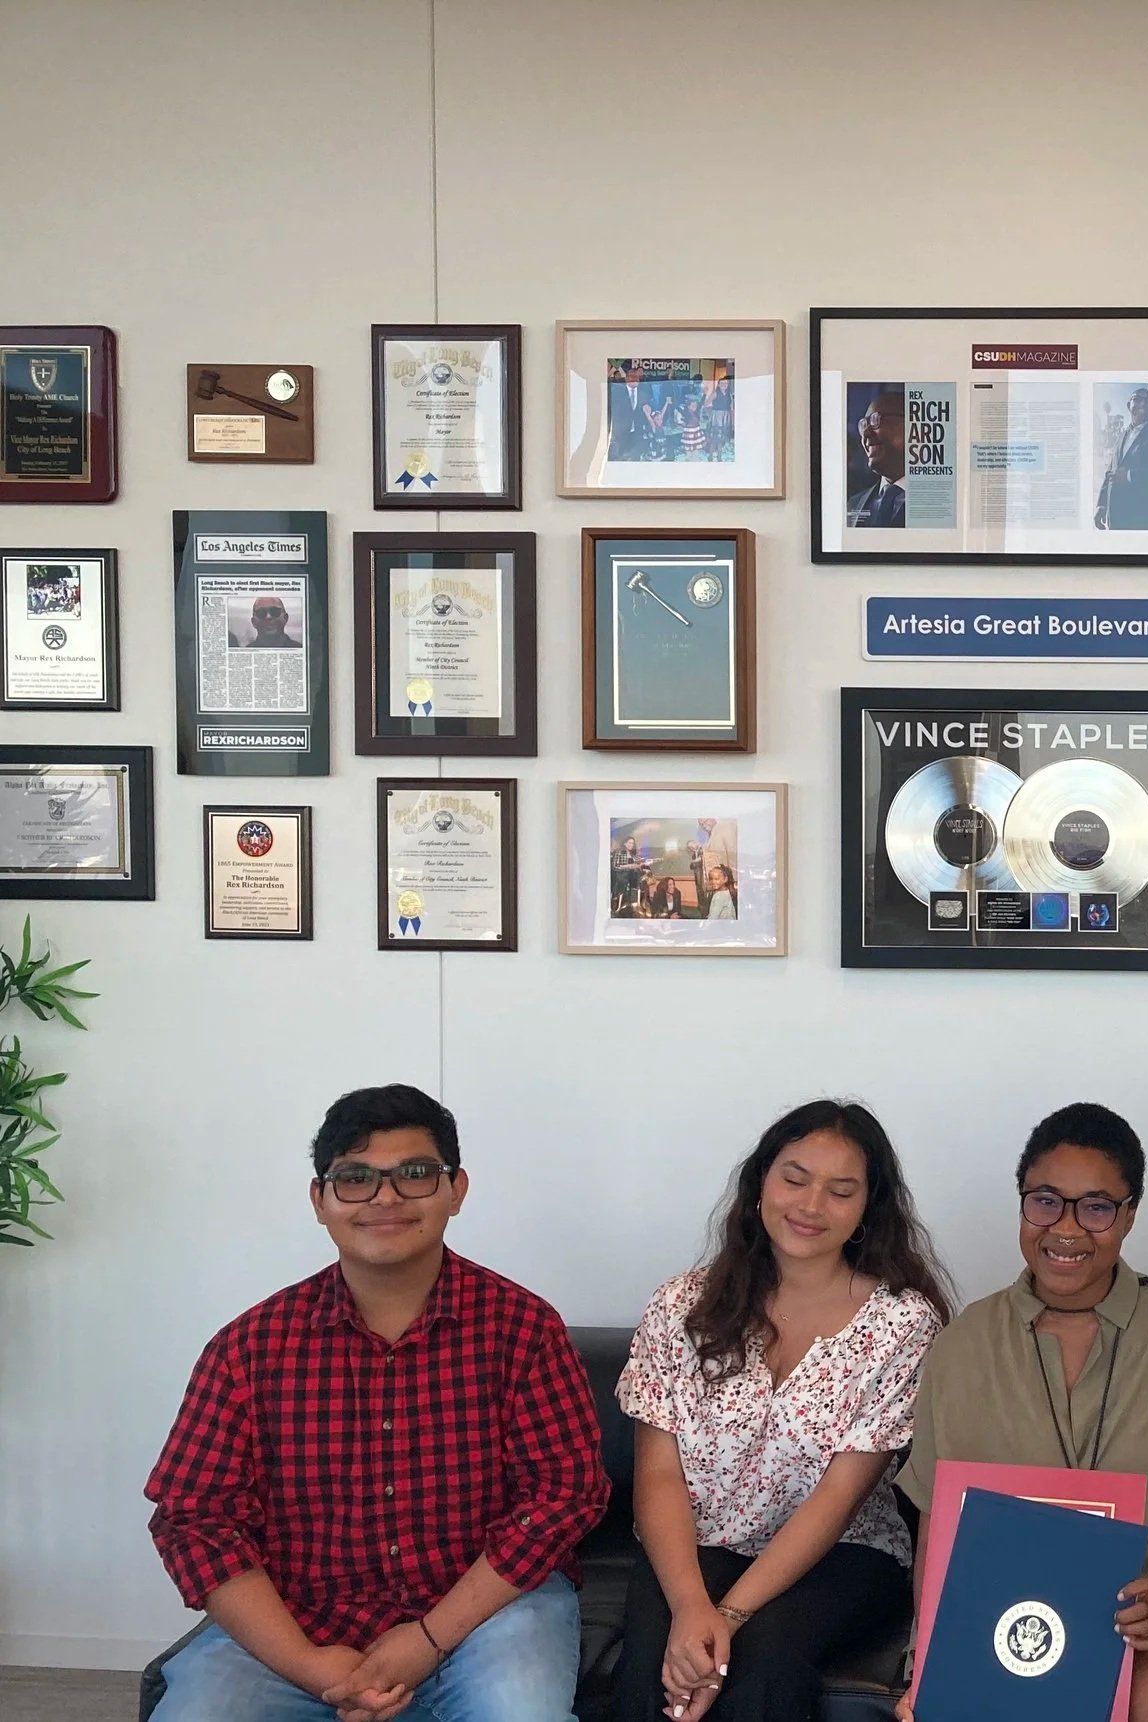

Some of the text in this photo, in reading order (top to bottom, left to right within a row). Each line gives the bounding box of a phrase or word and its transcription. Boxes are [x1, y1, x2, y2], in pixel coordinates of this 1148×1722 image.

[632, 359, 690, 370] Richardson
[909, 391, 923, 399] REX
[909, 401, 950, 422] RICH
[908, 423, 944, 443] ARD
[17, 446, 28, 454] City
[38, 446, 53, 454] Long
[908, 444, 944, 465] SON
[909, 466, 953, 475] REPRESENTS
[201, 541, 302, 554] Los Angeles Times
[883, 614, 965, 635] Artesia
[973, 614, 1041, 635] Great
[14, 654, 37, 662] Mayor
[876, 721, 989, 748] VINCE
